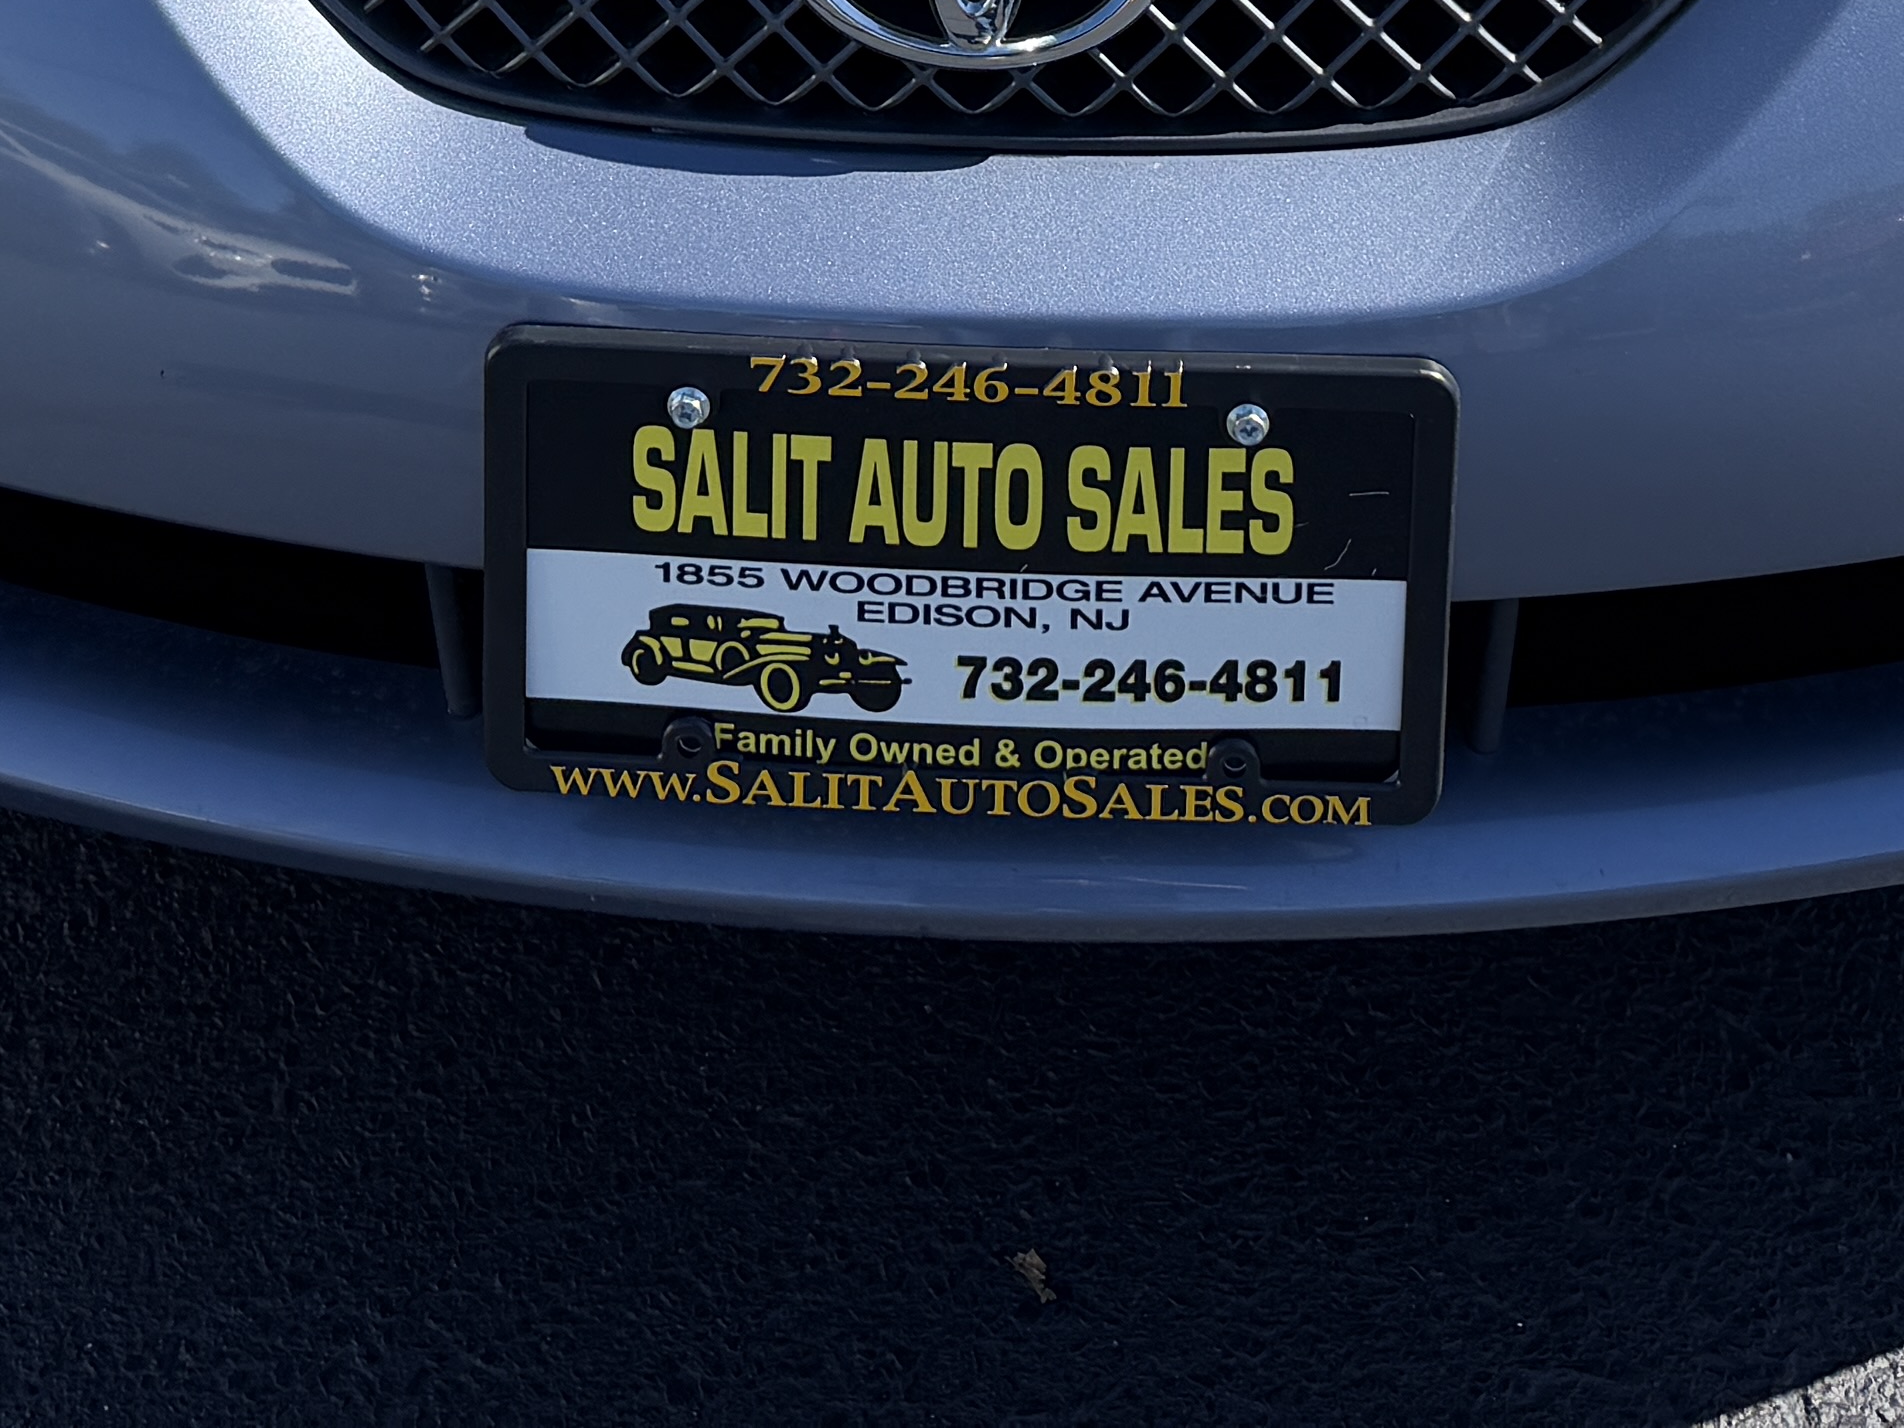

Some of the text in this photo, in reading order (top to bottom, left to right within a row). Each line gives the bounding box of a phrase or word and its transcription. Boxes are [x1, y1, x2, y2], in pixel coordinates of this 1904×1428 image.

[749, 353, 1188, 409] 732-246-4811
[632, 425, 1295, 556] SALIT AUTO SALES
[654, 561, 1336, 606] 1855 WOODBRIDGE AVENUE
[856, 600, 1131, 634] EDISON, NJ
[954, 655, 1343, 705] 732-246-4811
[714, 722, 1209, 770] Family Owned & Operated
